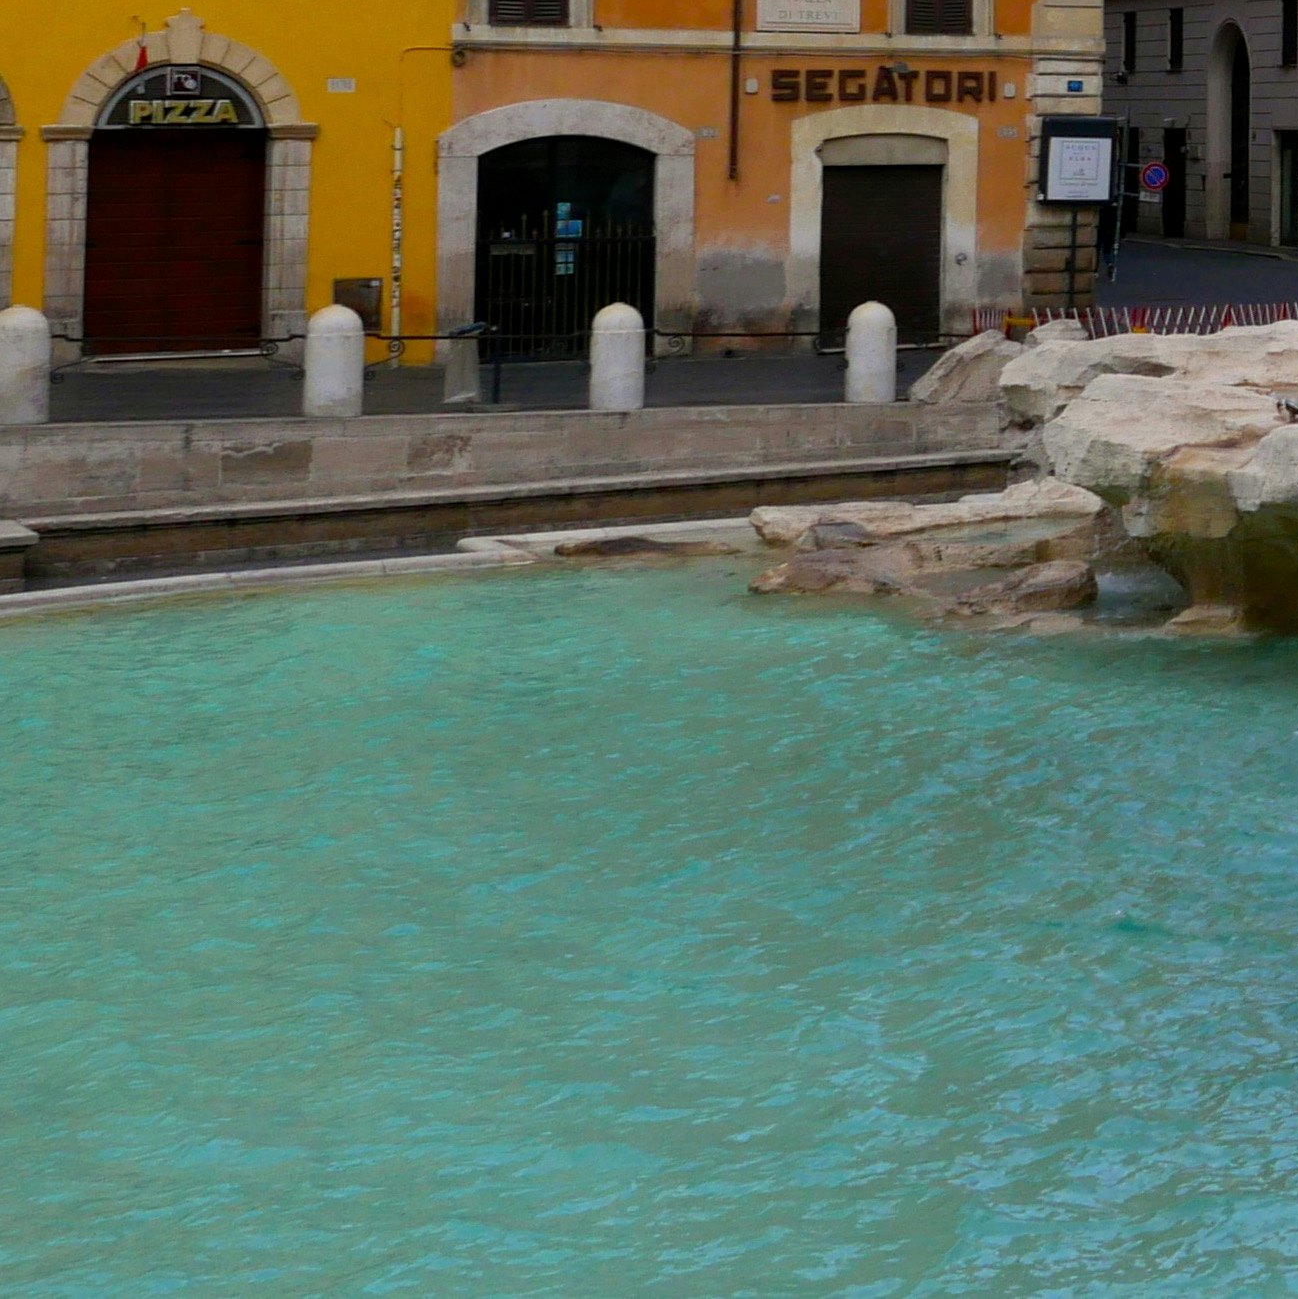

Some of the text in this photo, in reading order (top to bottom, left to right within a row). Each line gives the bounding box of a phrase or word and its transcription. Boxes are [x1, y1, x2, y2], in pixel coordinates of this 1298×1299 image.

[778, 10, 839, 21] DI TREVI
[771, 66, 997, 102] SEGATORI
[128, 99, 239, 124] PIZZA
